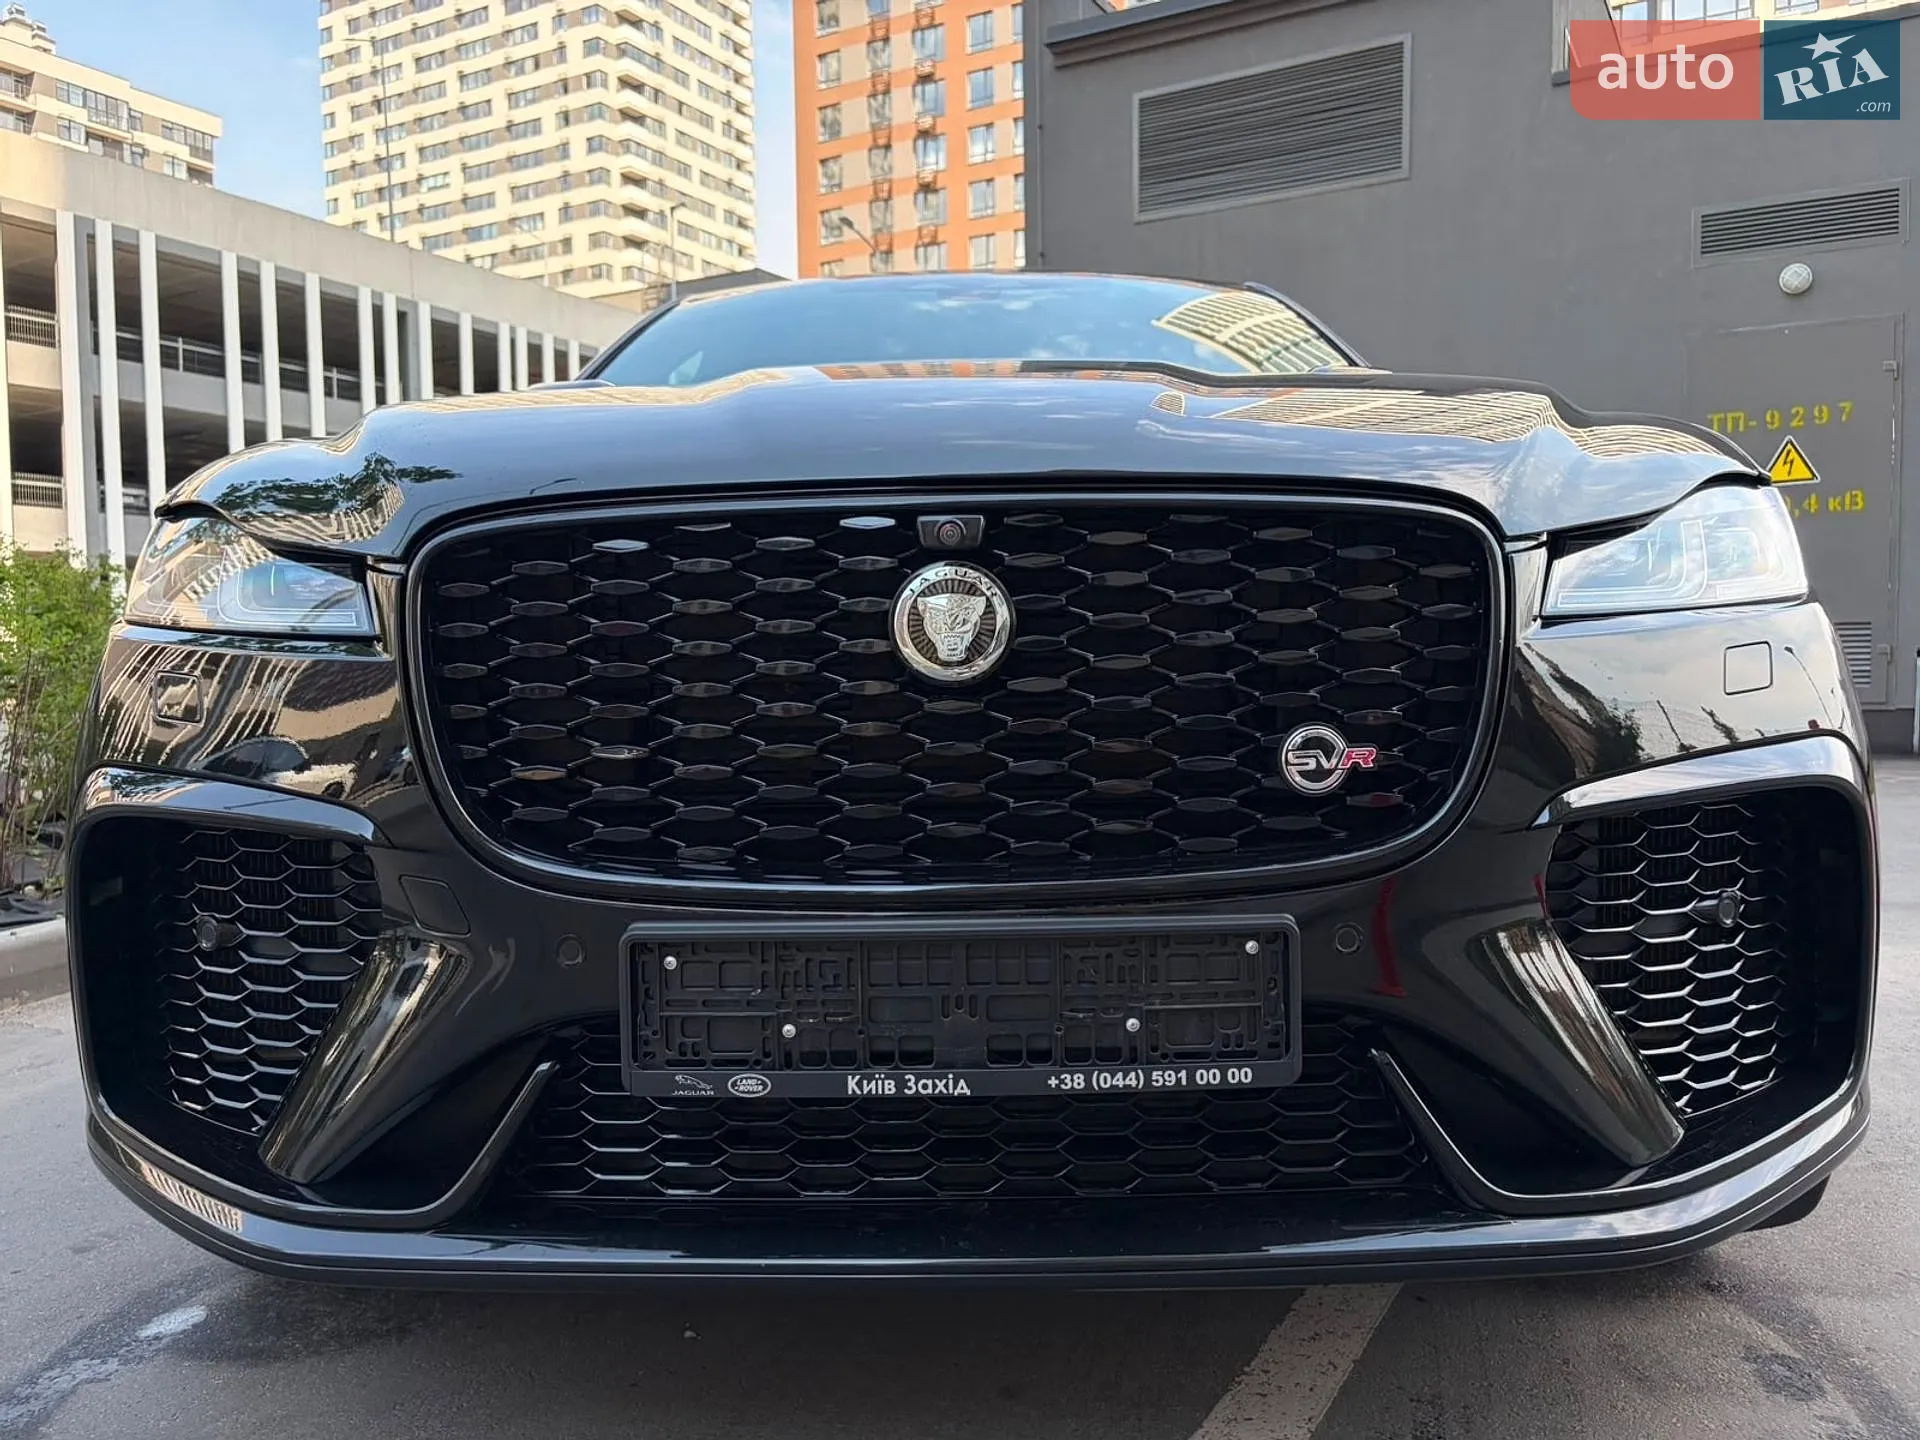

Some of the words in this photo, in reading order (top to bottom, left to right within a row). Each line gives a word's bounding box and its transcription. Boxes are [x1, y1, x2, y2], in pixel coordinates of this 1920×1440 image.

[909, 568, 998, 597] JAGUAR
[1286, 747, 1377, 772] SVR
[847, 1073, 897, 1095] Київ
[903, 1073, 971, 1096] Захід
[1048, 1073, 1085, 1090] +38
[1092, 1070, 1145, 1091] (044)
[1151, 1070, 1187, 1086] 591
[1195, 1068, 1221, 1085] 00
[1227, 1067, 1253, 1084] 00
